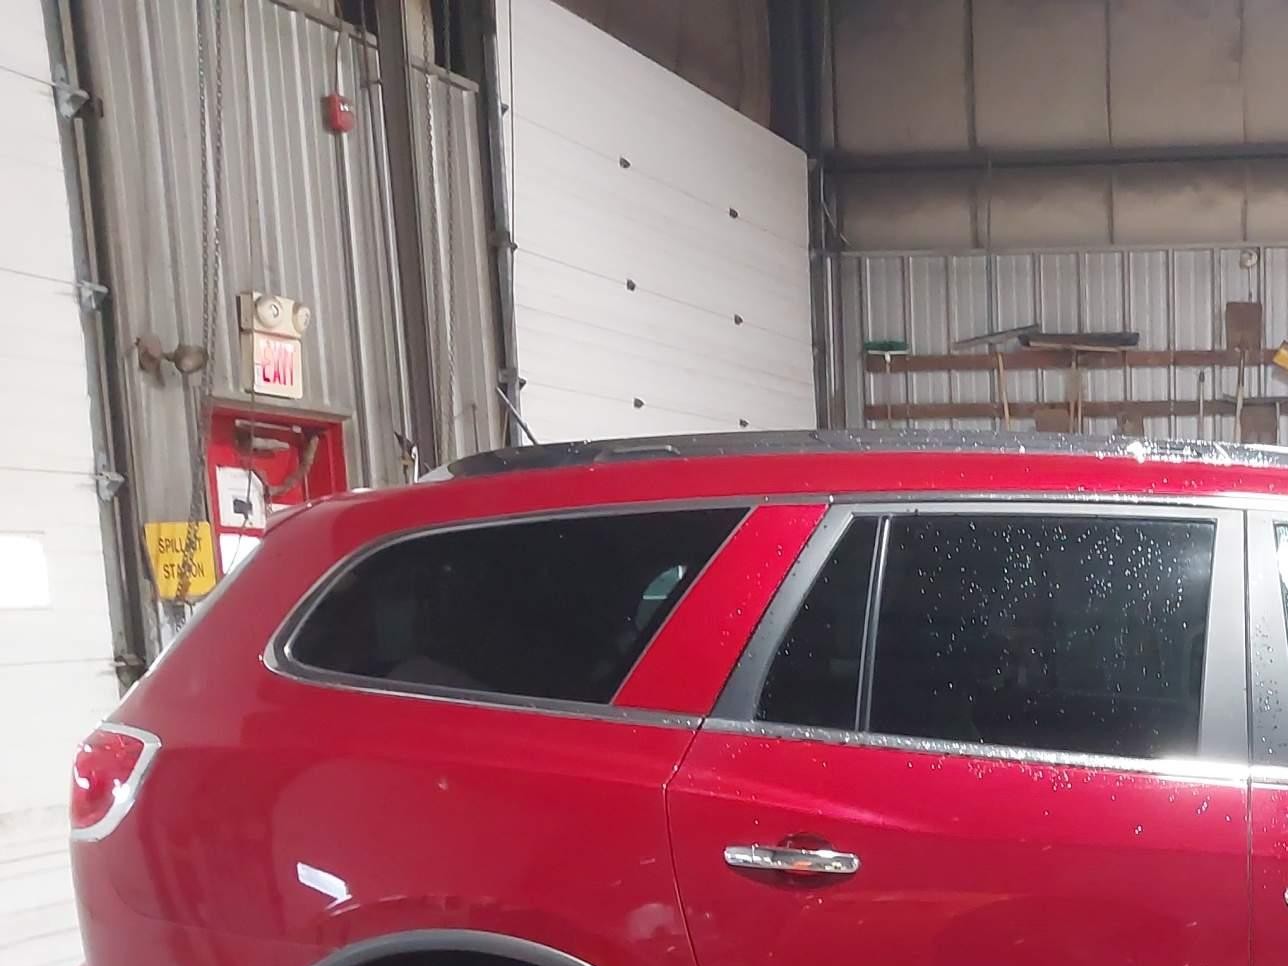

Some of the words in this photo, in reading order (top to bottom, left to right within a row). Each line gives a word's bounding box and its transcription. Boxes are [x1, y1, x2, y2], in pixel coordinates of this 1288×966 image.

[261, 344, 296, 386] EXIT
[158, 537, 186, 554] SPILL
[163, 562, 205, 579] STAON
